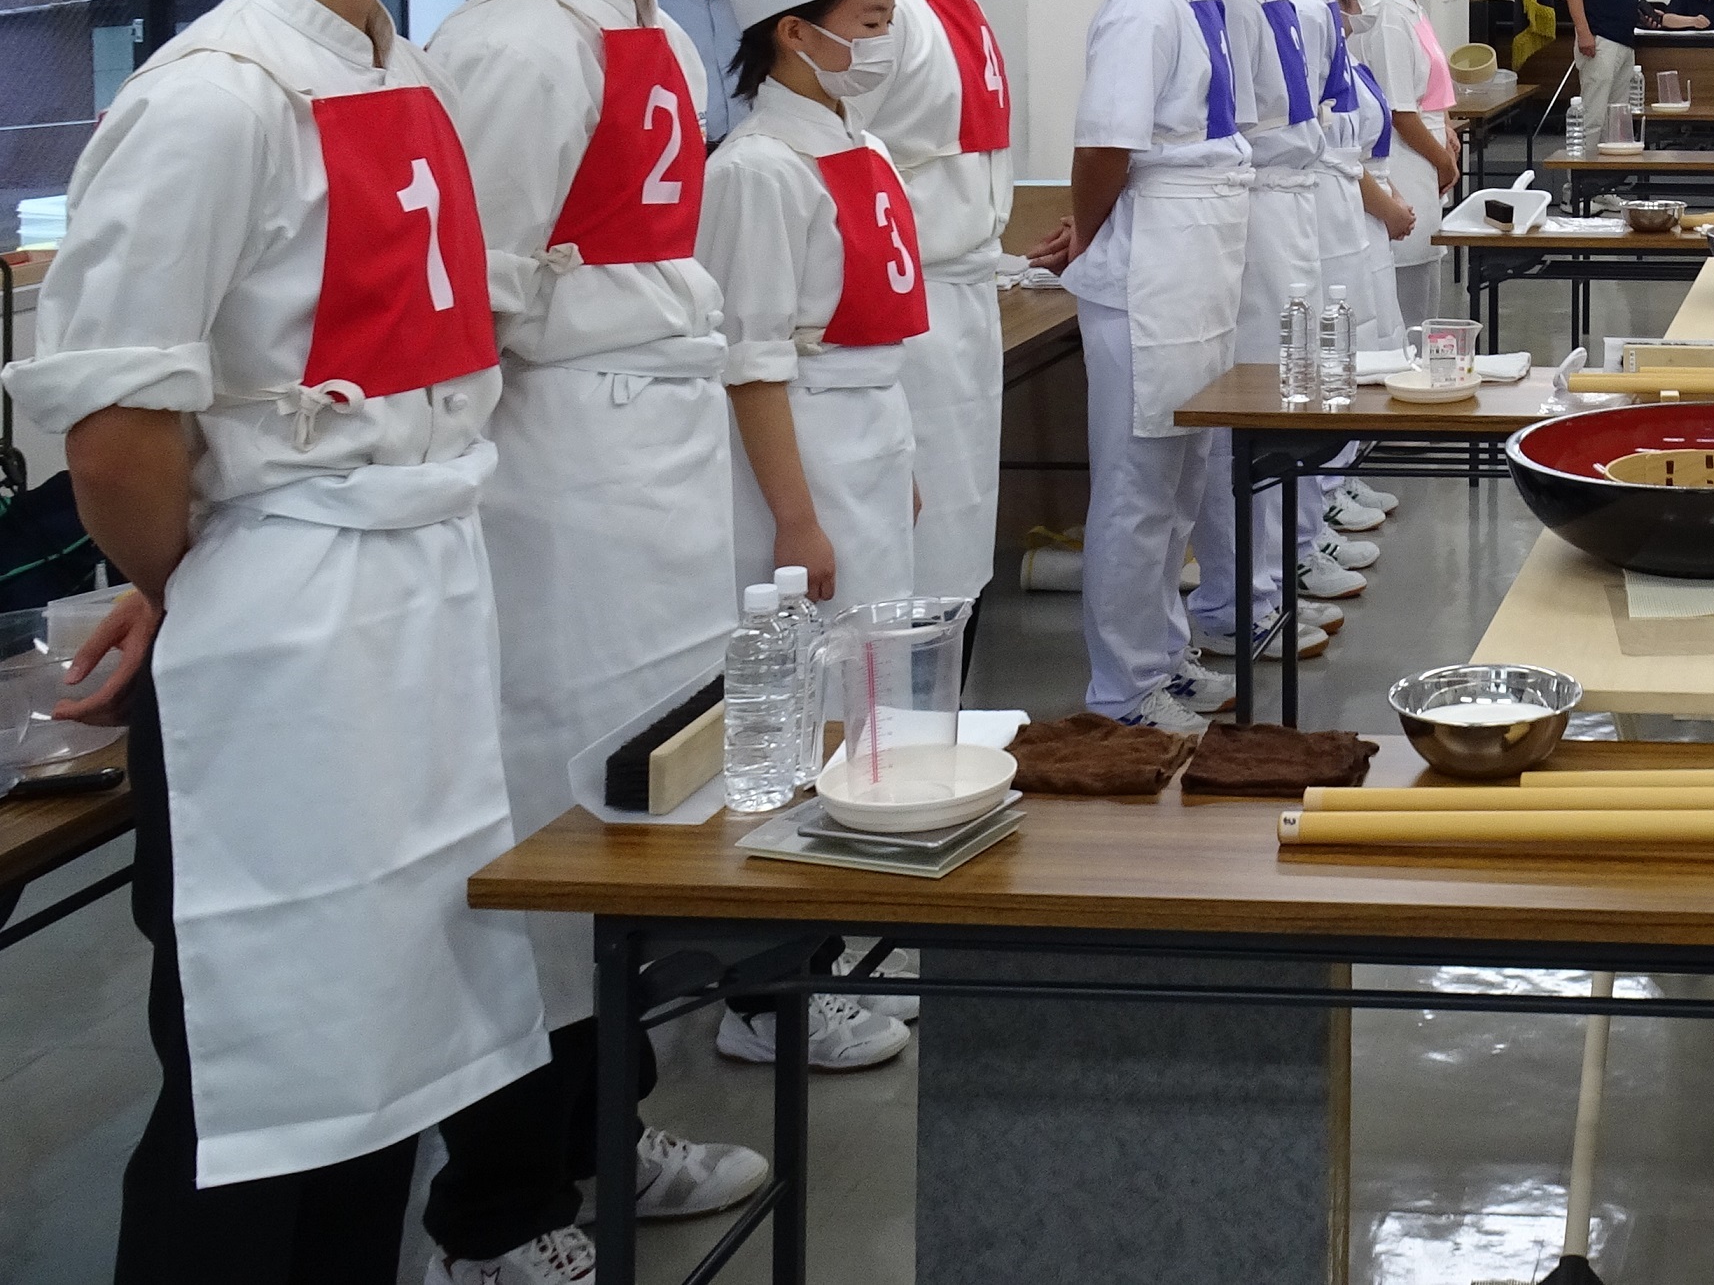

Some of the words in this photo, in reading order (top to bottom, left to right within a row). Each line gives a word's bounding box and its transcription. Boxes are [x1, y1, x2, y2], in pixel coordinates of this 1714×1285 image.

[981, 26, 1004, 108] 4
[641, 84, 682, 205] 2
[396, 158, 454, 311] 1
[876, 192, 914, 294] 3
